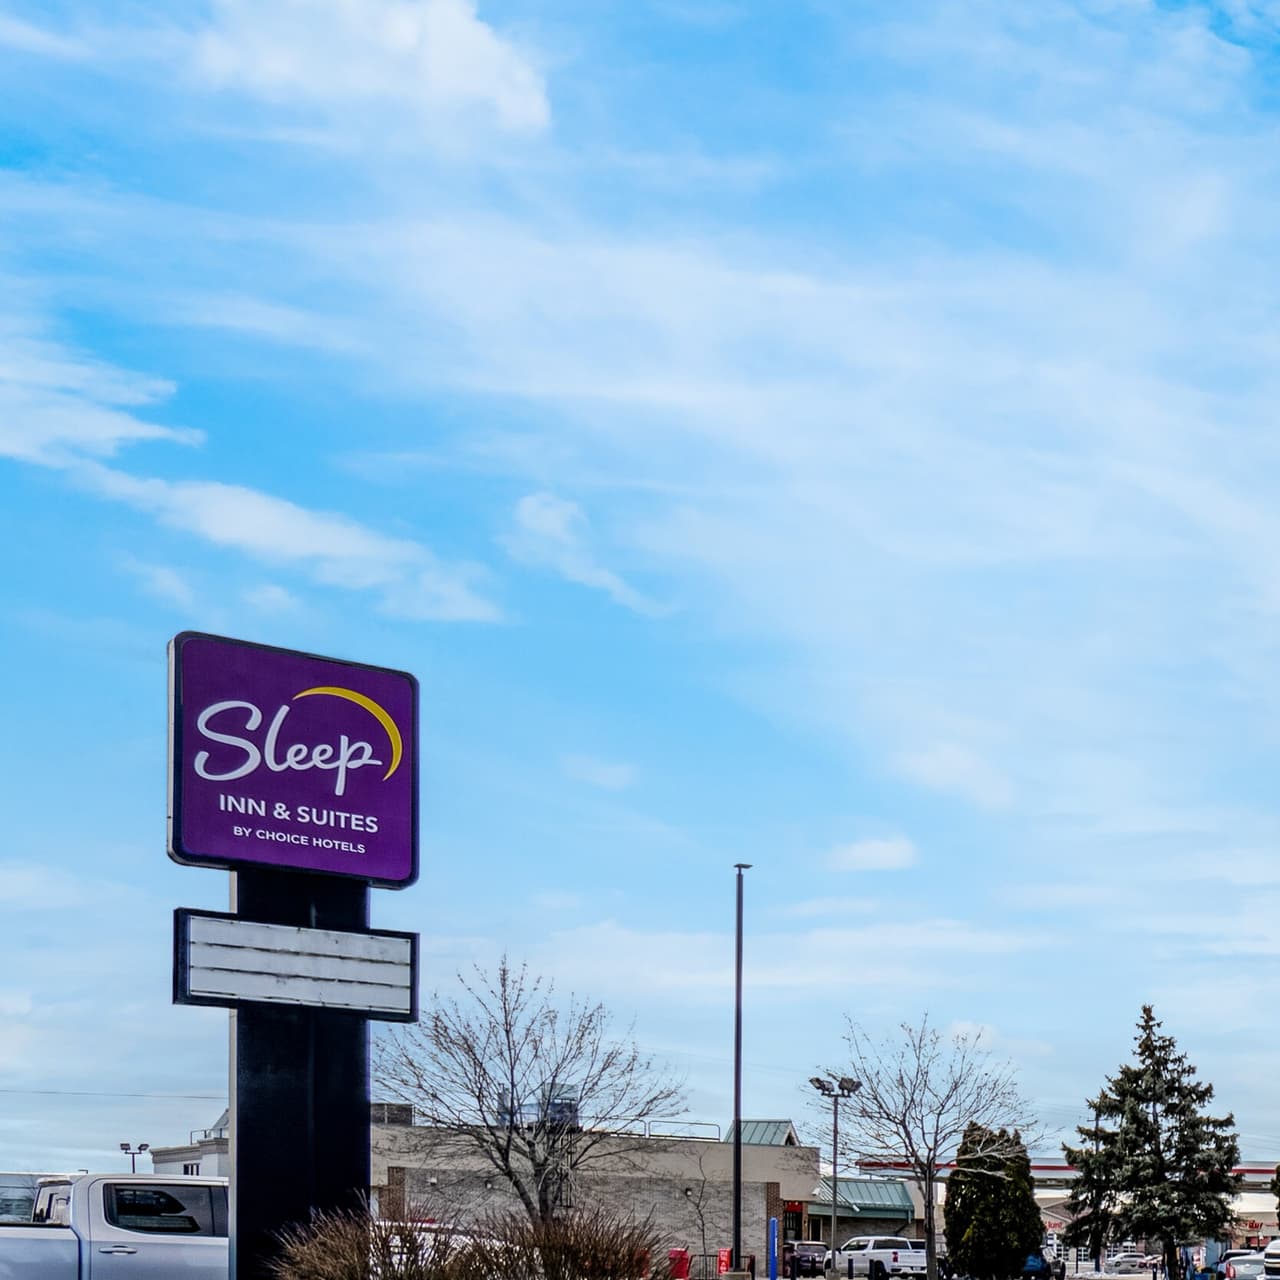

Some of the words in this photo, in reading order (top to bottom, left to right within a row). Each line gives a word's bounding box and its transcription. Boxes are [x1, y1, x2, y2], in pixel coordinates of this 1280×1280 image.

[194, 700, 383, 796] Sleep
[219, 794, 267, 817] INN
[272, 802, 292, 821] &
[296, 806, 379, 833] SUITES
[232, 825, 252, 838] BY
[256, 829, 309, 846] CHOICE
[312, 837, 366, 854] HOTELS
